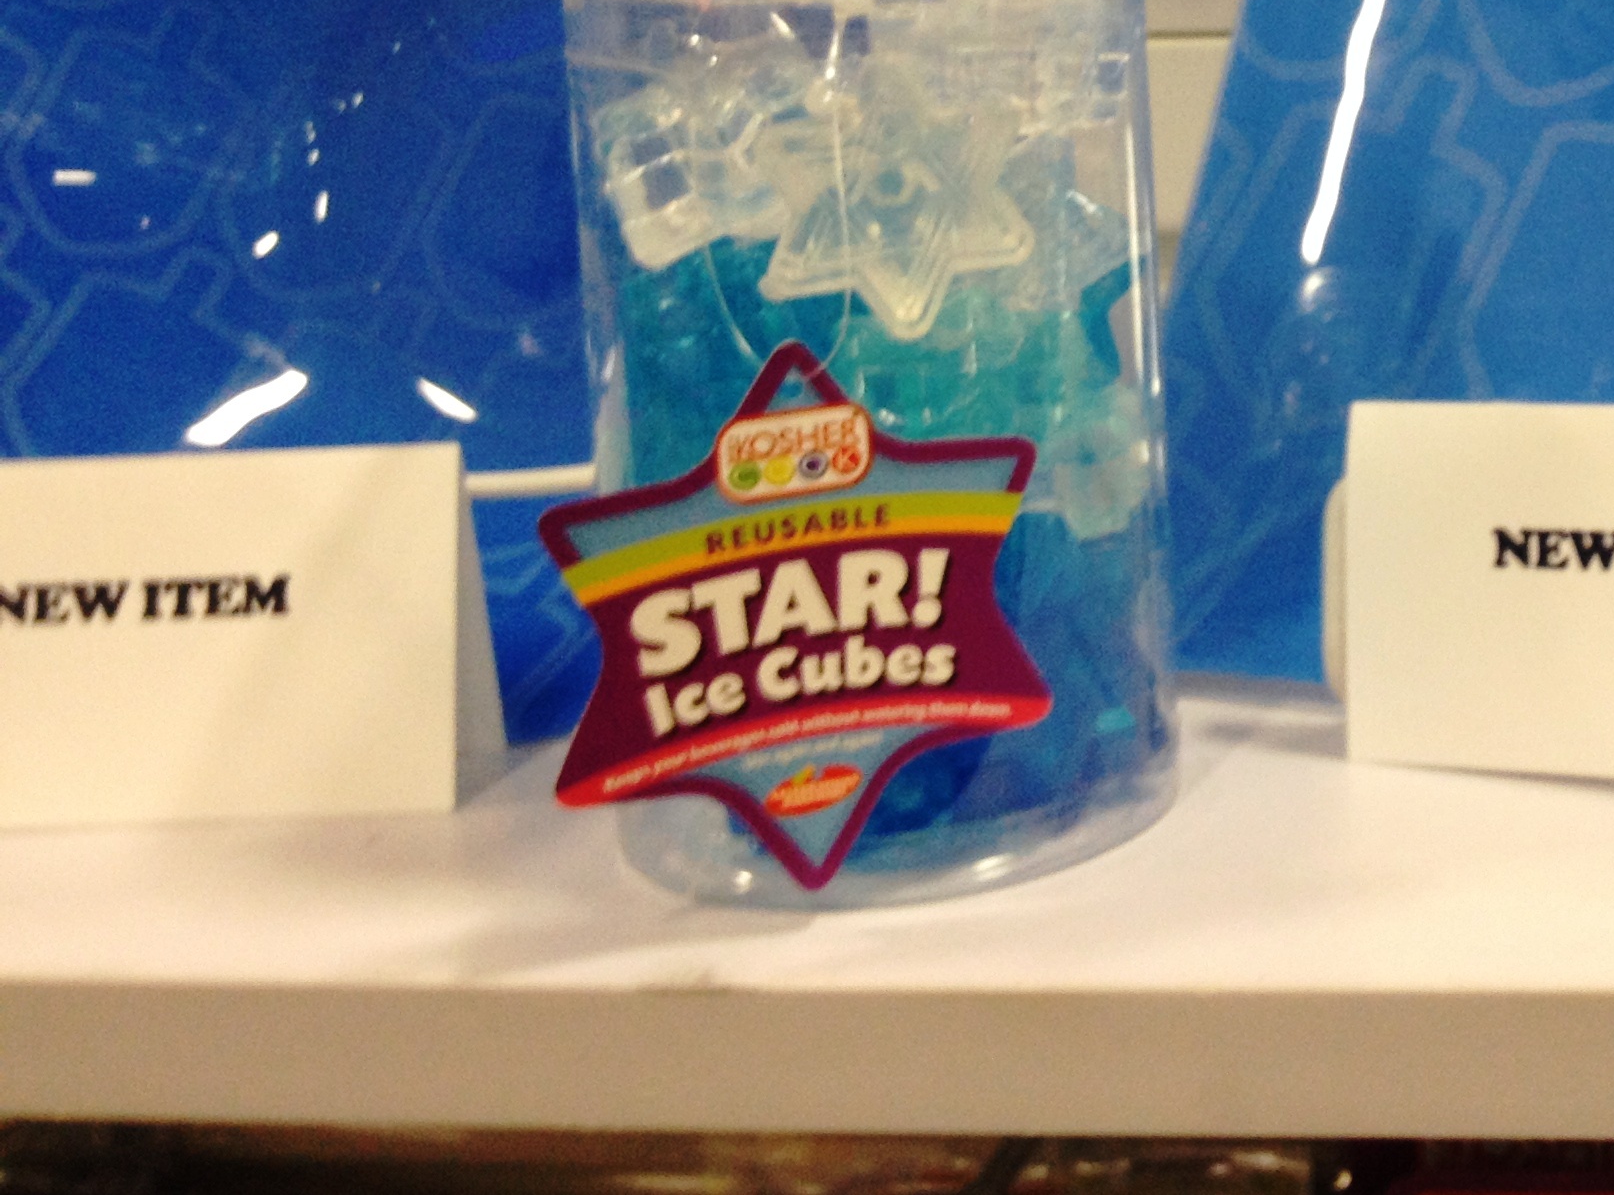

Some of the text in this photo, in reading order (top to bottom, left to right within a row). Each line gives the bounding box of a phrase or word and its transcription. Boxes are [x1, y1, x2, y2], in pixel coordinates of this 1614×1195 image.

[727, 418, 860, 464] KOSHER
[706, 504, 892, 553] REUSABLE
[0, 572, 291, 627] NEW ITEM
[630, 548, 949, 677] STAR!
[644, 634, 957, 738] Ice Cubes
